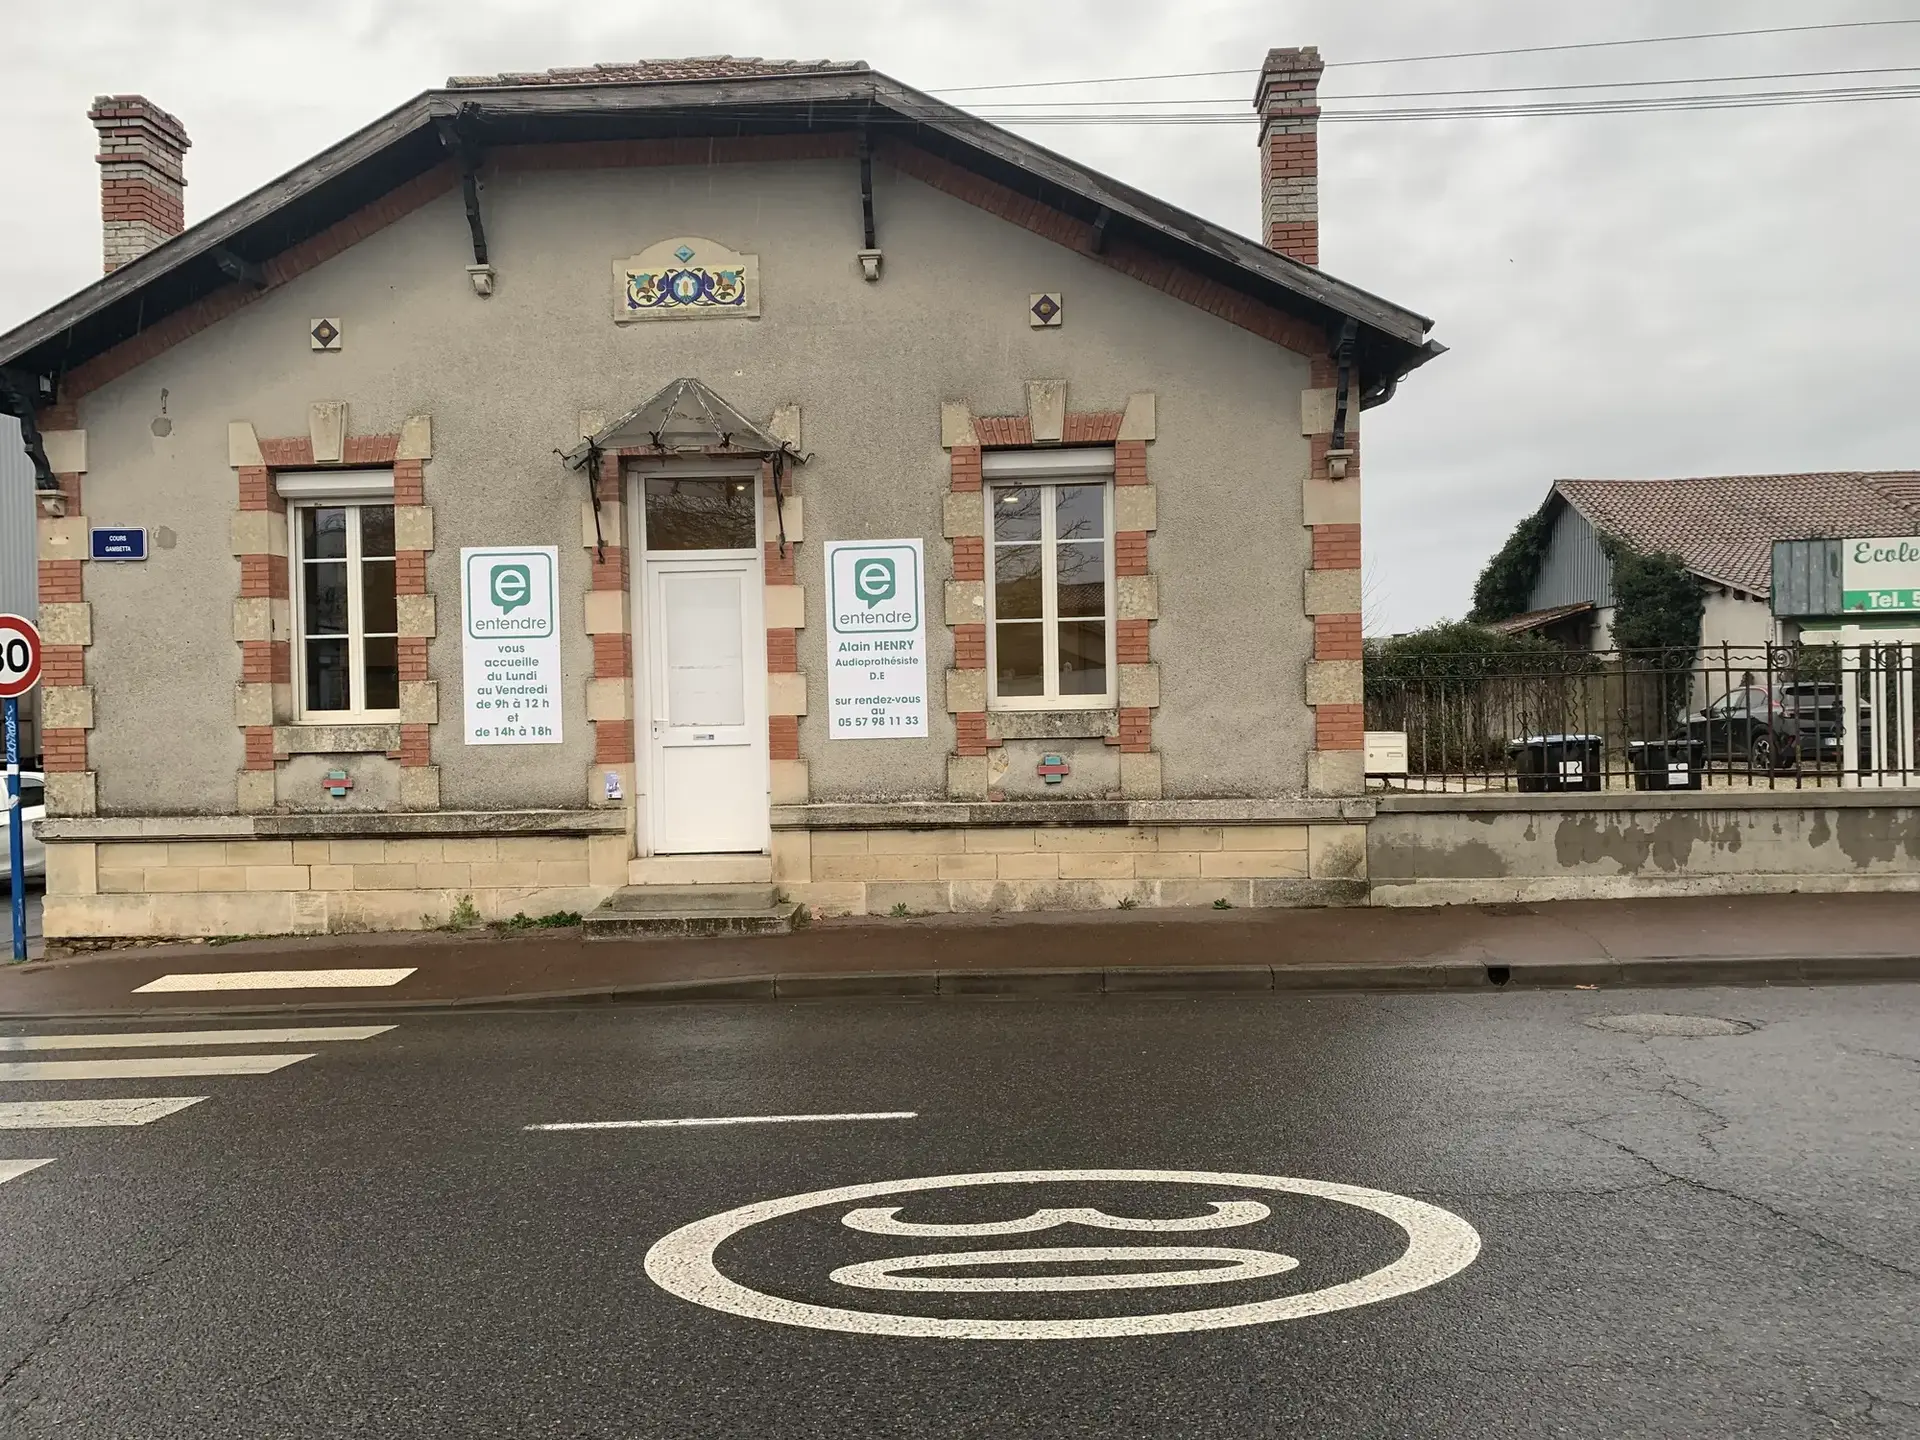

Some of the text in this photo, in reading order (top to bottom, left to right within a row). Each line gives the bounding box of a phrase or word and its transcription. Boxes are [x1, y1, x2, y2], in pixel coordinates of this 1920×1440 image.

[1854, 542, 1920, 563] Ecole
[1868, 592, 1905, 607] Tel.
[840, 611, 912, 624] entendre
[475, 617, 547, 630] entendre
[498, 645, 525, 653] vous
[839, 640, 914, 652] Alain HENRY
[0, 638, 29, 672] 0
[484, 657, 539, 667] accueille
[835, 657, 918, 668] Audioprothésiste
[487, 670, 538, 681] du Lundi
[869, 672, 885, 680] D.E
[477, 684, 548, 695] au Vendredi
[476, 698, 549, 709] de 9h à 12 h
[835, 694, 921, 706] sur rendez-vous
[871, 706, 885, 715] au
[507, 712, 519, 722] et
[838, 716, 919, 727] 05 57 98 11 33
[475, 726, 552, 737] de 14h à 18h
[829, 1200, 1300, 1292] 30
